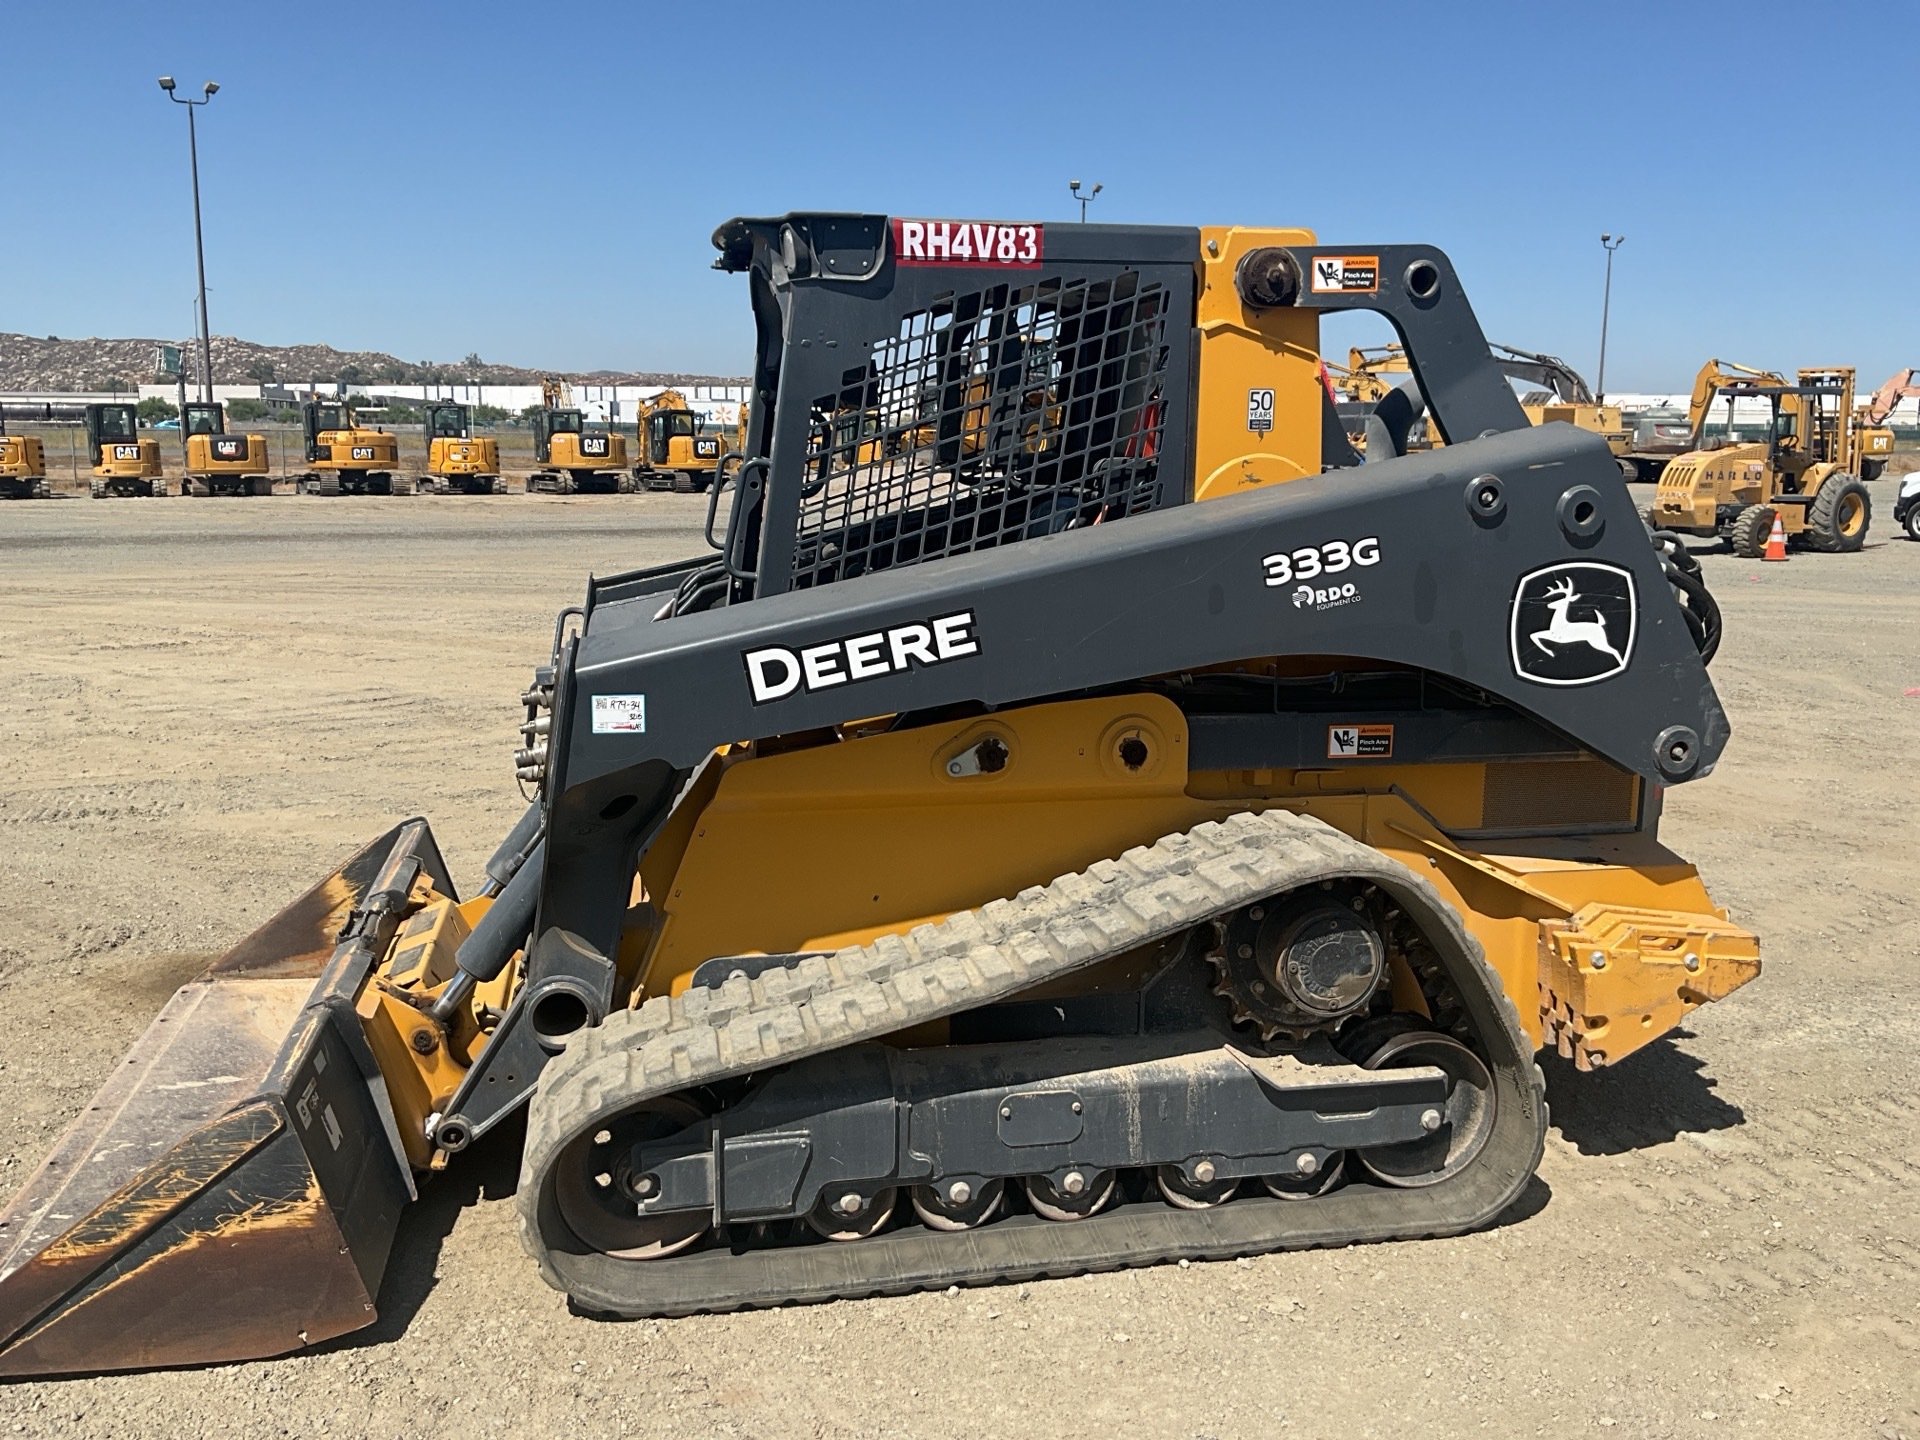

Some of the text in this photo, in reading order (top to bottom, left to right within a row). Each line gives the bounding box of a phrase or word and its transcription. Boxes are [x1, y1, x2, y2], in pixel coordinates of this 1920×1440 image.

[902, 222, 1037, 264] RH4V83
[1250, 391, 1273, 411] 50
[584, 439, 605, 453] CAT
[697, 442, 716, 454] CAT
[1873, 437, 1888, 450] CAT
[116, 446, 138, 460] CAT
[353, 448, 373, 459] CAT
[1706, 471, 1763, 481] HARLO
[1262, 537, 1381, 587] 333G
[1316, 595, 1361, 611] EQUIPMENT CO
[745, 611, 978, 702] DEERE
